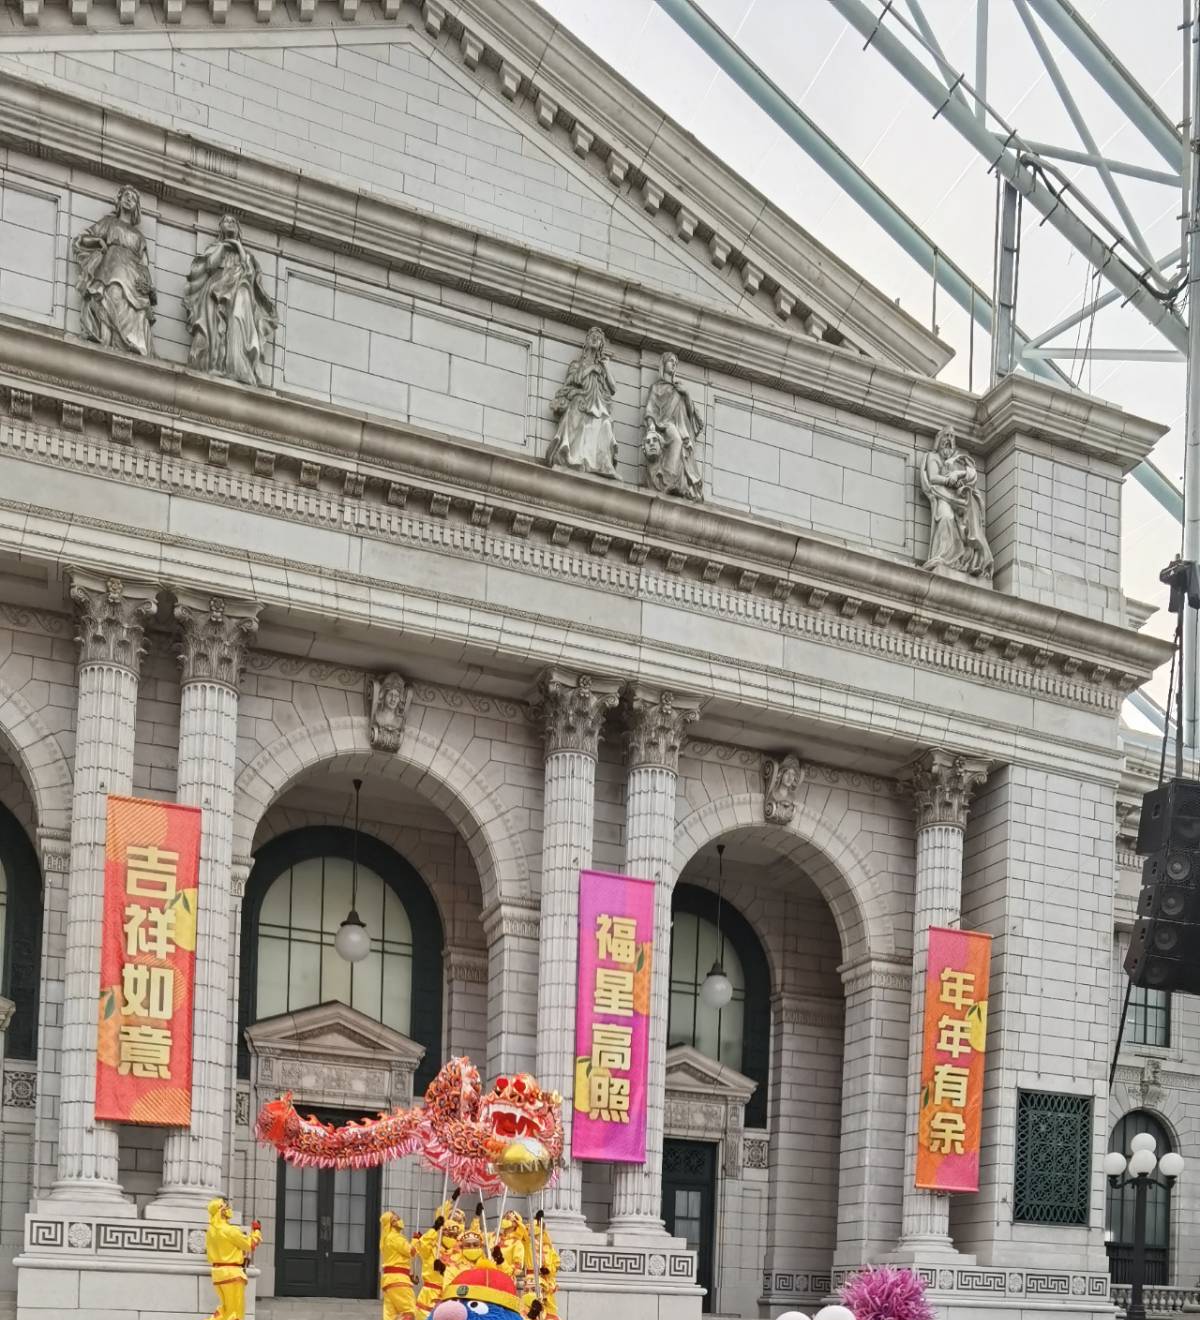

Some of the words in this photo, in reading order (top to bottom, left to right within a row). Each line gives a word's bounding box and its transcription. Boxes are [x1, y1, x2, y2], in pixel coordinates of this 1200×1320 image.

[118, 846, 180, 1079] 吉祥如意
[589, 913, 637, 1123] 福星高照
[930, 967, 976, 1155] 年年有余
